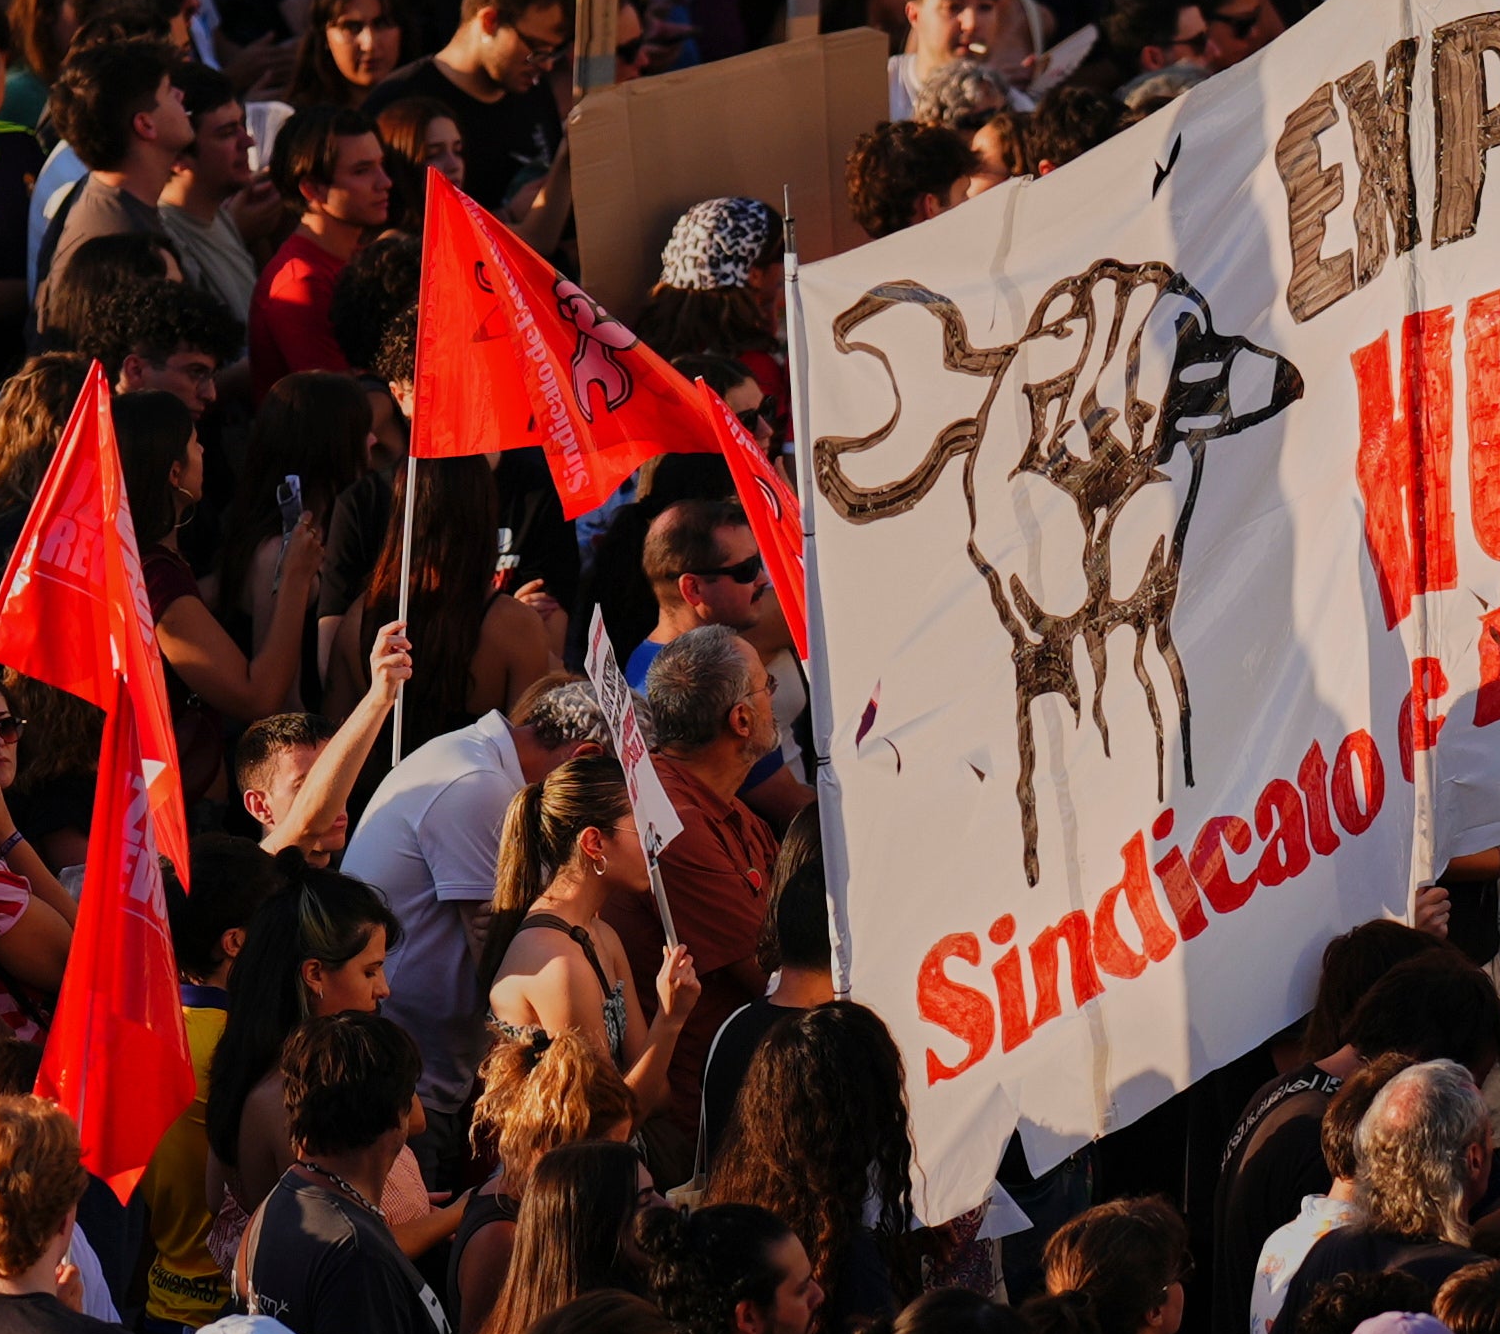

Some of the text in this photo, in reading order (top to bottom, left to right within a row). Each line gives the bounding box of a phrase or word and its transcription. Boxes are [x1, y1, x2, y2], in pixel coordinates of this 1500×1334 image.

[524, 324, 548, 365] de
[538, 361, 591, 495] Sindicato
[916, 727, 1385, 1086] Sindicato
